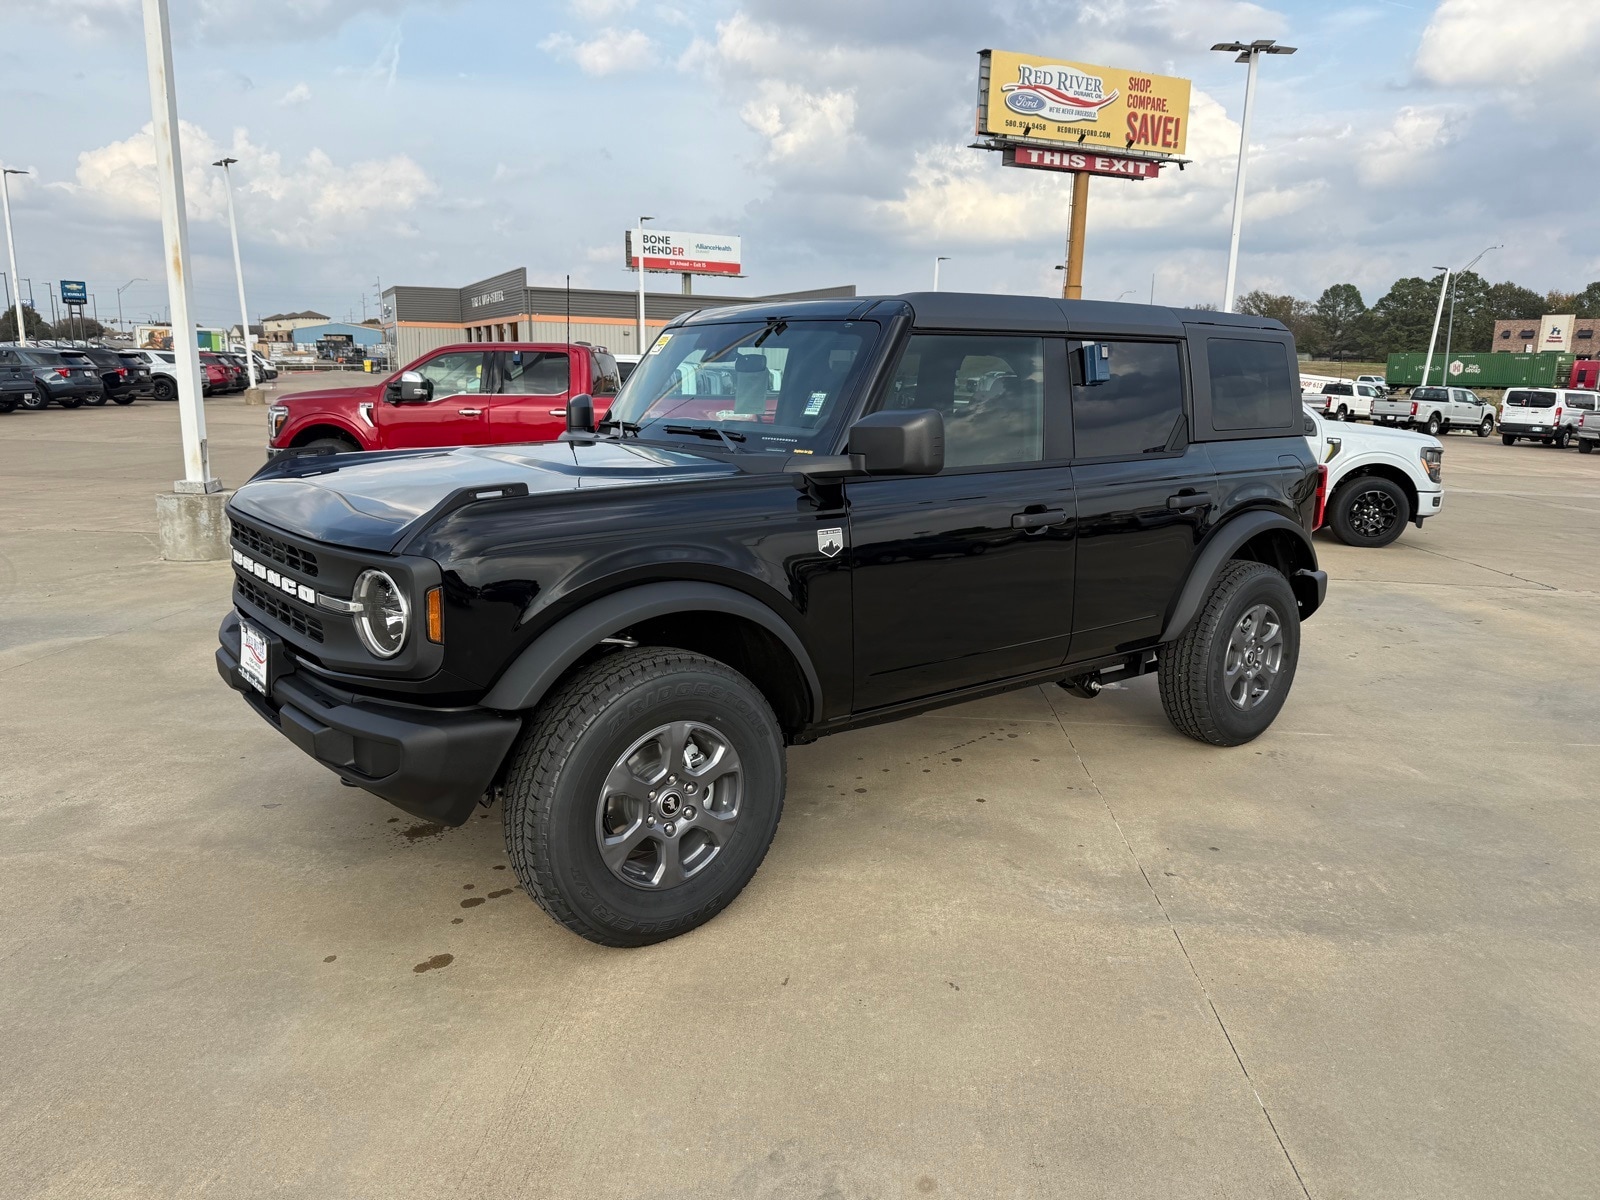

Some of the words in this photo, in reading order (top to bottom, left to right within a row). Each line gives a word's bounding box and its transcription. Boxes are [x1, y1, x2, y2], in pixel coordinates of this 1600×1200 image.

[1021, 66, 1053, 87] RED
[1057, 71, 1102, 93] RIVER
[1128, 76, 1152, 94] SHOP.
[1015, 94, 1039, 109] Ford
[1127, 93, 1169, 113] COMPARE.
[1005, 119, 1047, 131] 580.9249458
[1057, 126, 1111, 139] REDRIVERFORD.COM
[1125, 111, 1181, 149] SAVE!
[1027, 149, 1086, 168] THIS
[1094, 157, 1150, 174] EXIT
[643, 234, 671, 245] BONE
[643, 245, 684, 256] MENDER
[232, 548, 316, 604] BRONCO
[606, 682, 770, 739] BRIDGESTONE
